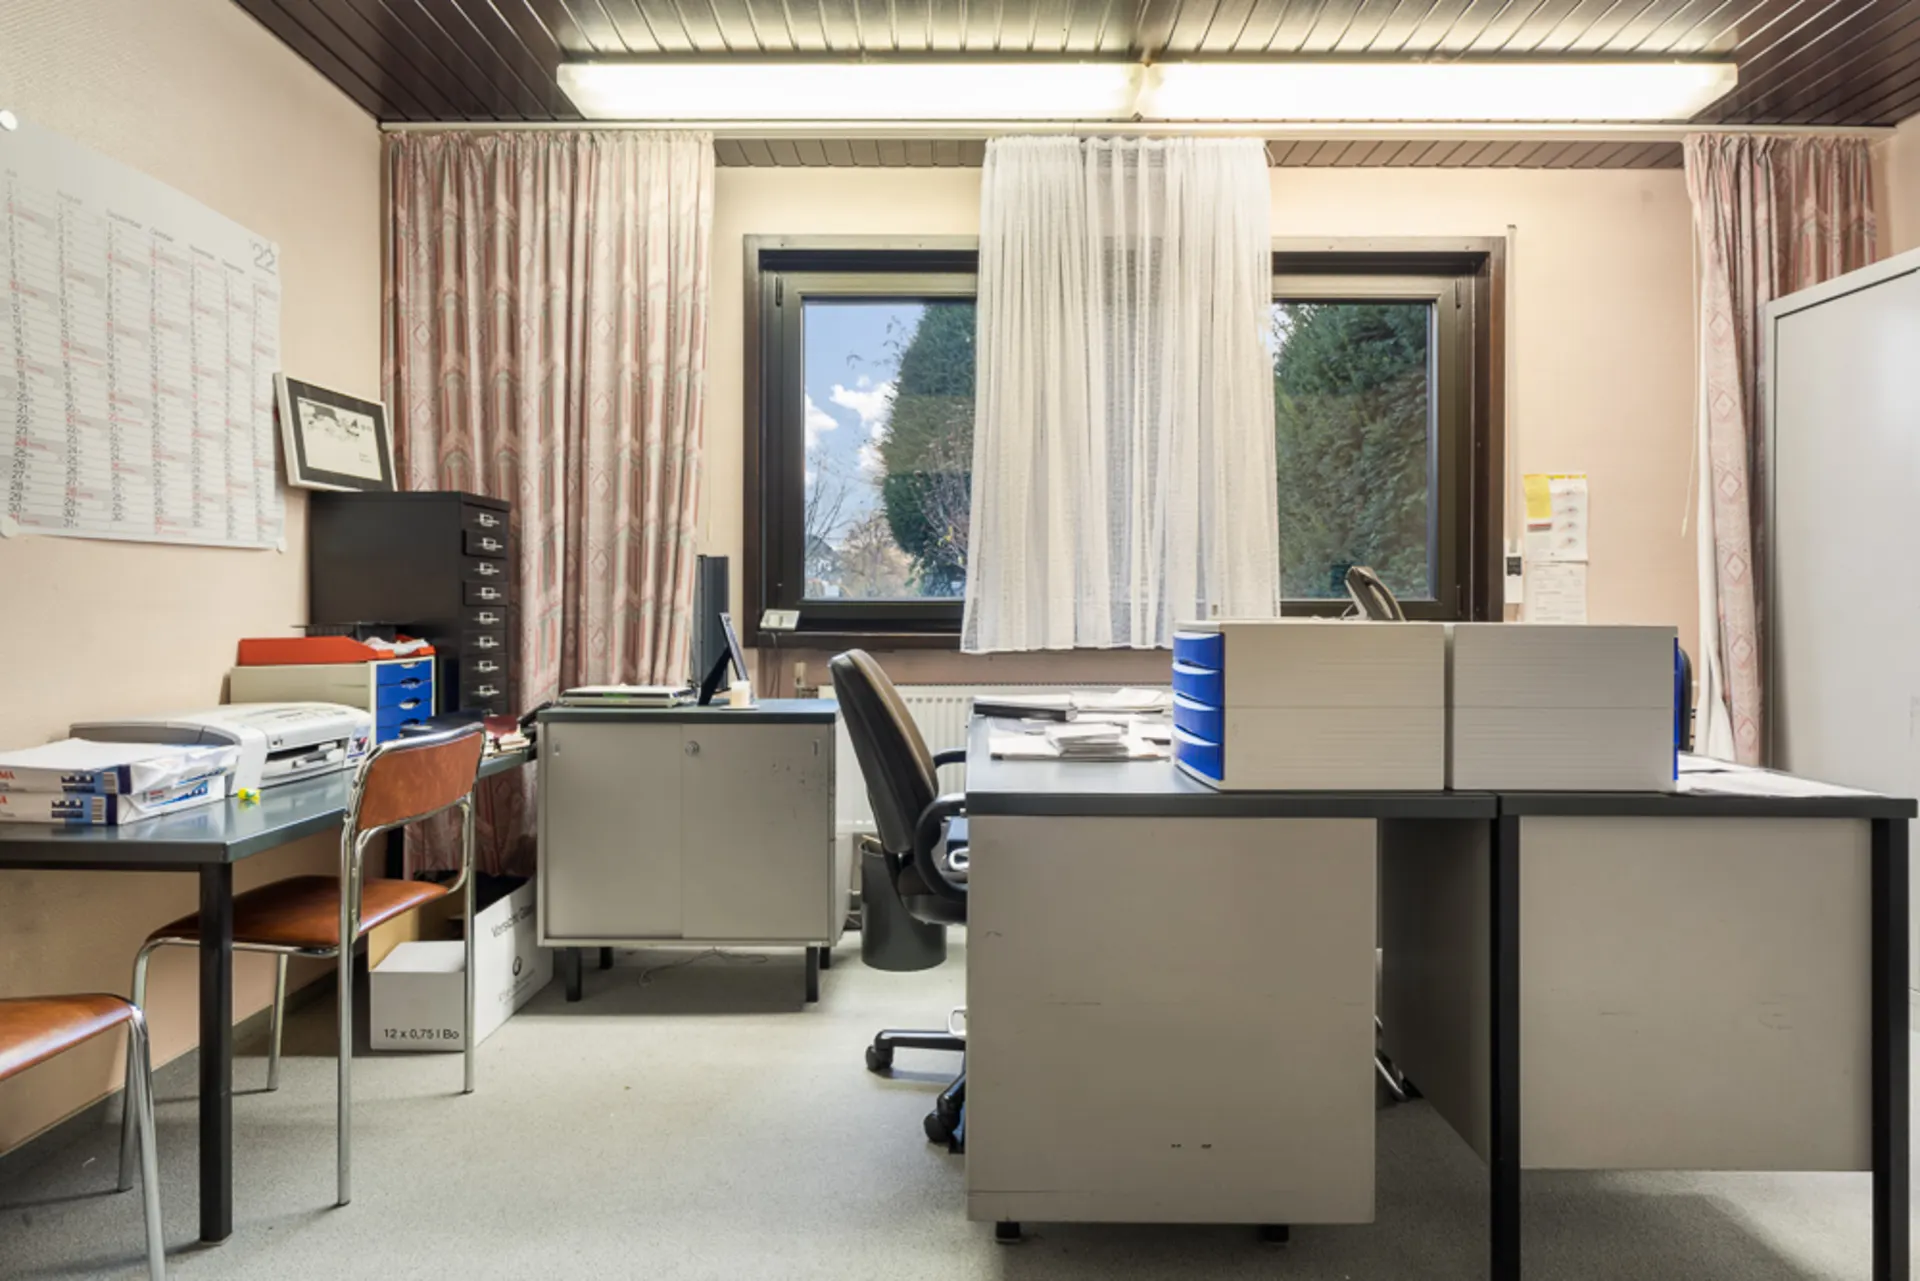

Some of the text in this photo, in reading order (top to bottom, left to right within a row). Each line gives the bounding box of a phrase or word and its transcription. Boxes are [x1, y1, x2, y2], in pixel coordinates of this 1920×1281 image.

[383, 1028, 397, 1040] 12
[399, 1031, 407, 1039] x
[409, 1028, 434, 1040] 0,75
[443, 1028, 460, 1040] Bo
